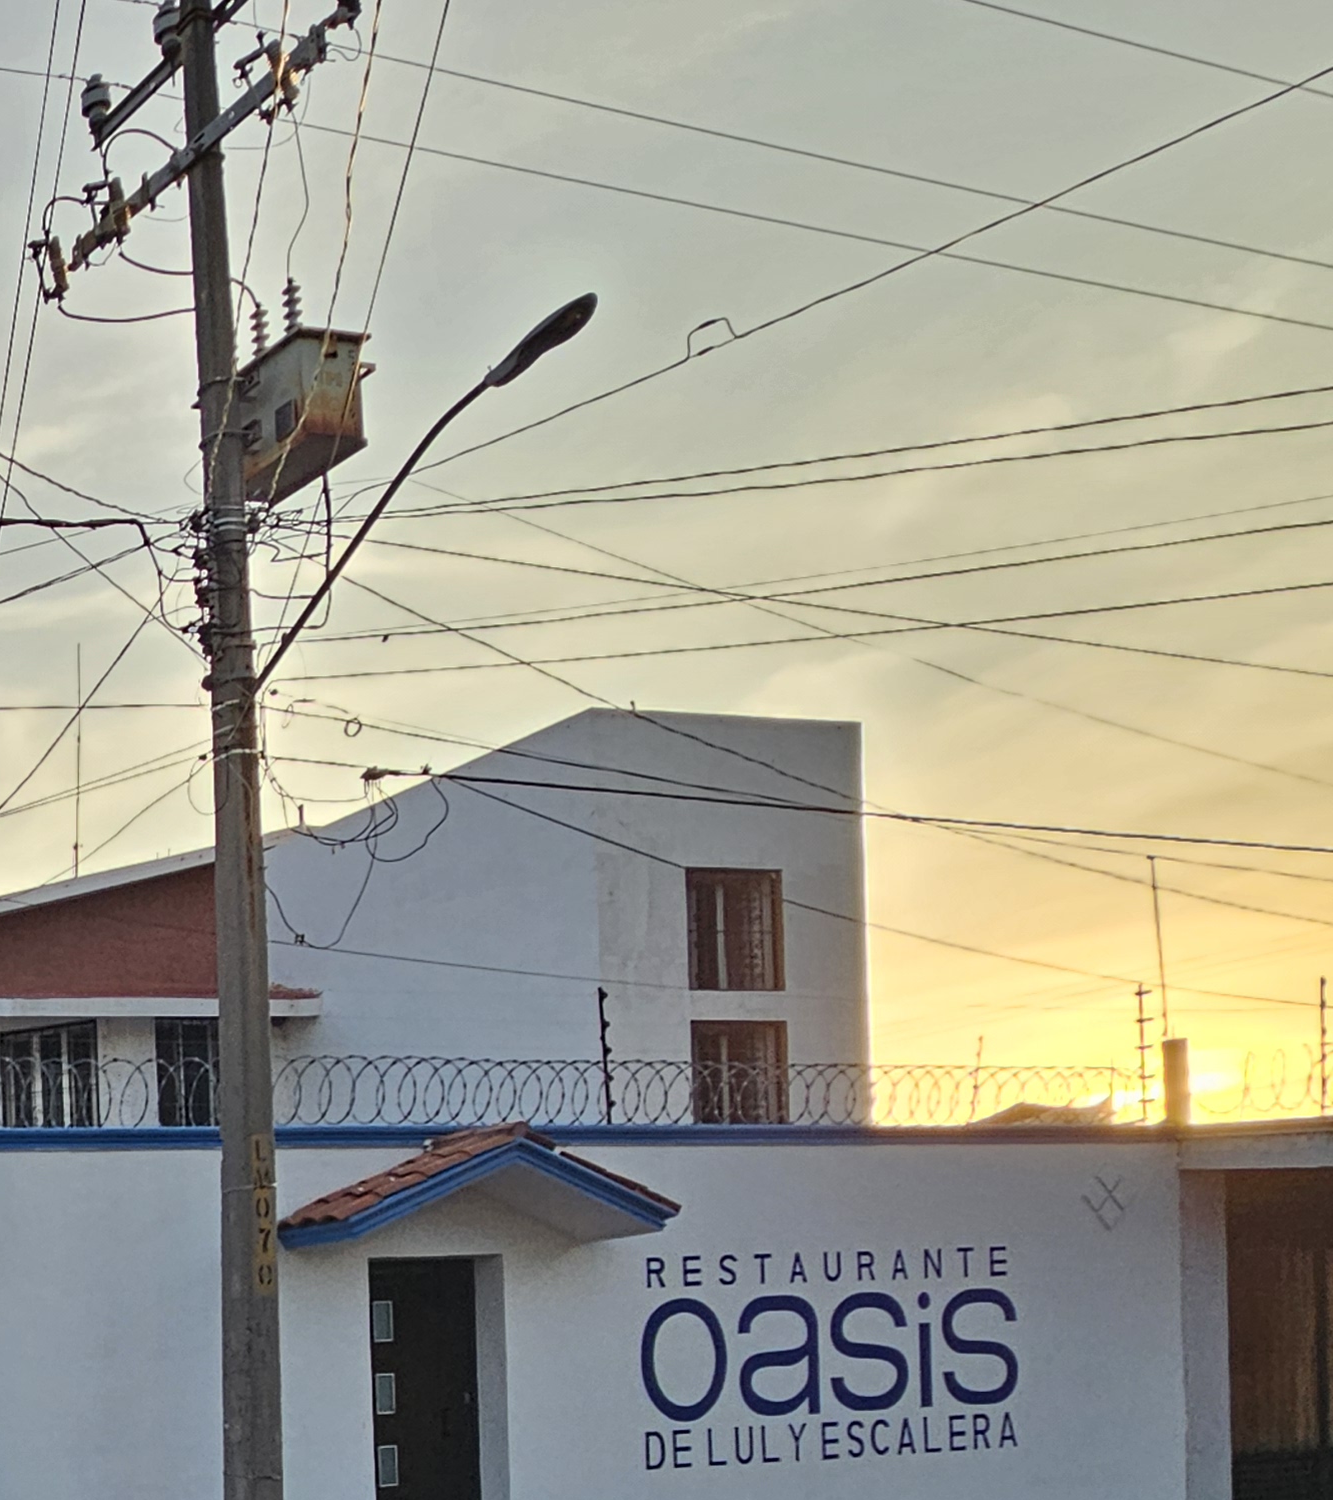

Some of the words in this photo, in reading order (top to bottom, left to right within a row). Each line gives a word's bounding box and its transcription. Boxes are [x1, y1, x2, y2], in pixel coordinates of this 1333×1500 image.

[646, 1246, 1008, 1288] RESTAURANTE
[645, 1429, 693, 1471] DE
[708, 1422, 807, 1467] LULY
[821, 1411, 1019, 1461] ESCALERA
